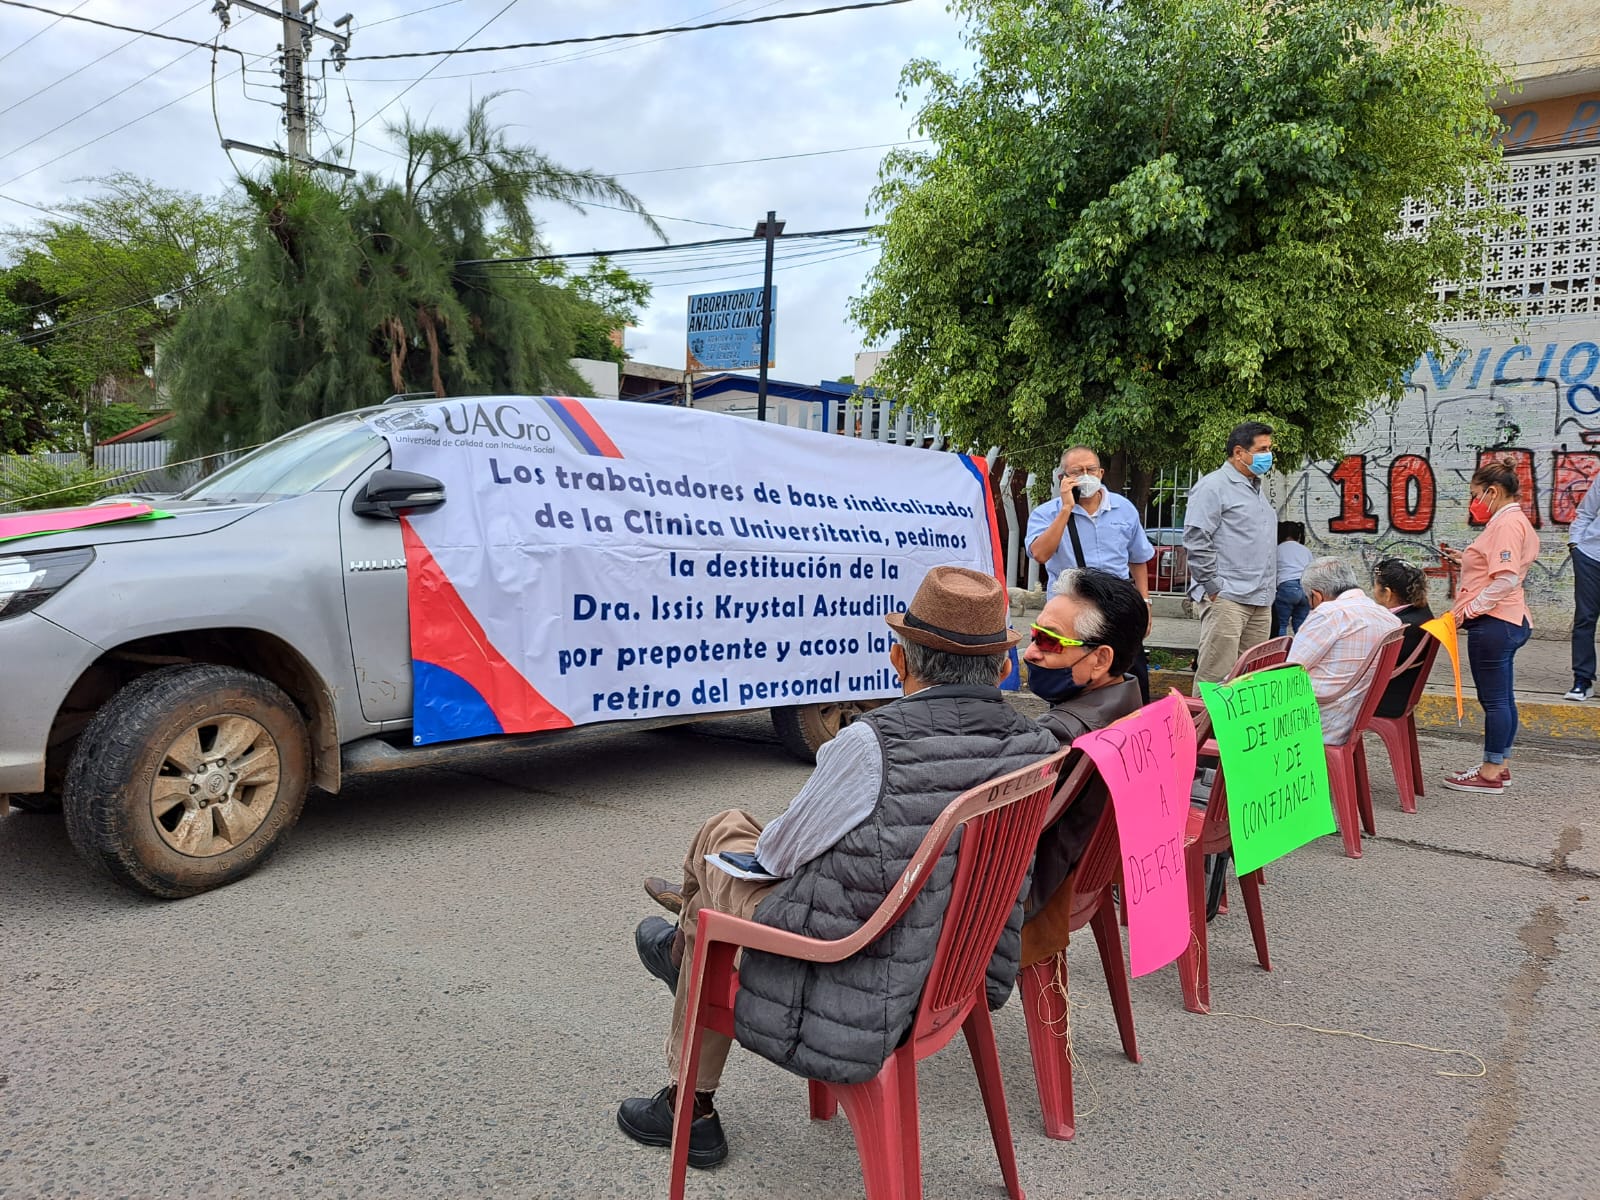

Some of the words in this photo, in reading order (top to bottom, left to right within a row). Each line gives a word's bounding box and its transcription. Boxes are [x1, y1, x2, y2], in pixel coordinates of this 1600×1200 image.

[688, 313, 730, 332] ANALISIS
[731, 309, 771, 328] CLINIC
[691, 292, 755, 314] LABORATORIO
[440, 403, 550, 441] UAGro
[396, 436, 441, 447] Universidad
[442, 438, 453, 447] de
[454, 439, 483, 448] Calidad
[501, 441, 532, 452] Inclusión
[533, 445, 555, 454] Social
[489, 458, 545, 485] Los
[555, 466, 744, 501] trabajadores
[753, 482, 781, 504] de
[788, 485, 837, 509] base
[843, 494, 974, 519] sindicalizados
[1328, 453, 1438, 534] 10
[534, 503, 574, 529] de
[581, 508, 613, 532] la
[730, 516, 890, 546] Universitaria,
[895, 527, 967, 549] pedimos
[350, 559, 406, 571] HILUX
[670, 552, 694, 577] la
[706, 552, 842, 578] destitución
[850, 557, 874, 579] de
[881, 558, 898, 579] la
[573, 594, 640, 621] Dra.
[652, 595, 703, 620] Issis
[715, 594, 804, 623] Krystal
[813, 594, 907, 617] Astudillo
[558, 647, 603, 675] por
[616, 638, 767, 671] prepotente
[776, 641, 790, 662] y
[799, 638, 859, 656] acoso
[868, 631, 898, 652] lab
[593, 684, 681, 711] retiro
[691, 678, 727, 705] del
[739, 671, 840, 705] personal
[848, 669, 902, 691] unila
[1212, 680, 1283, 720] RETIRO
[1242, 722, 1268, 752] DE
[1095, 728, 1159, 782] POR
[1286, 742, 1302, 772] DE
[1160, 784, 1170, 817] A
[1242, 770, 1317, 840] CONFIANZA
